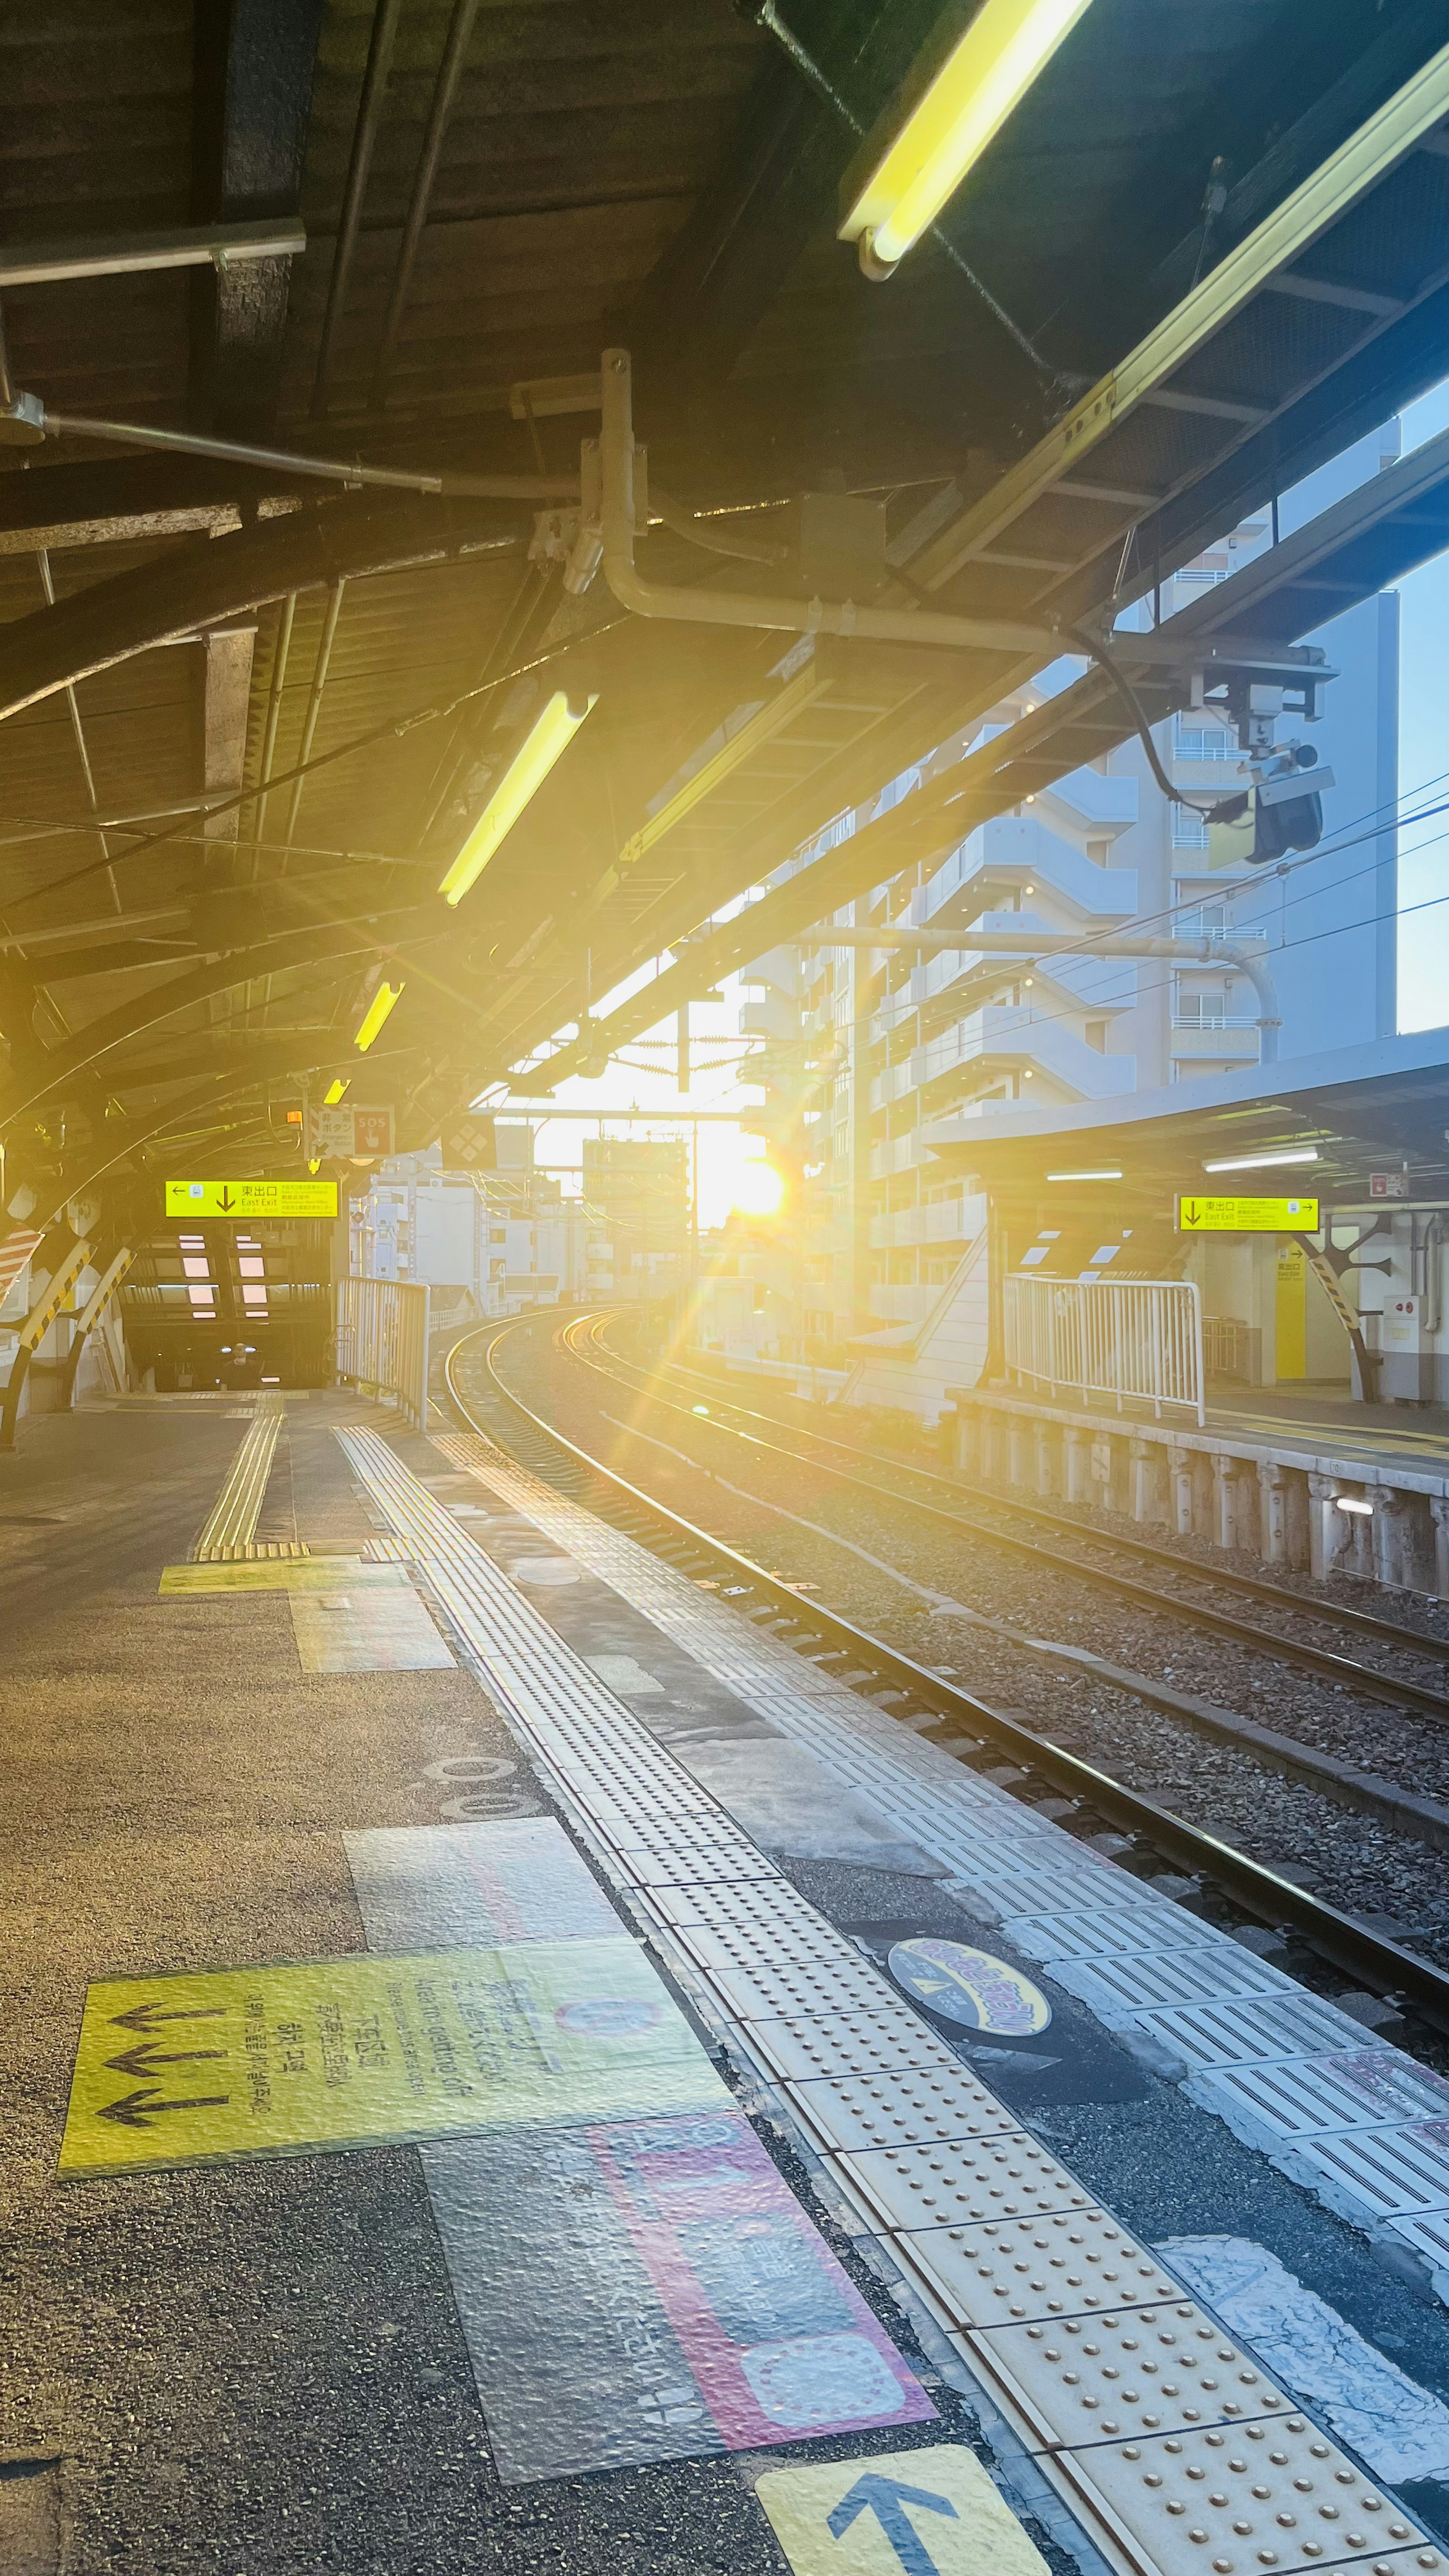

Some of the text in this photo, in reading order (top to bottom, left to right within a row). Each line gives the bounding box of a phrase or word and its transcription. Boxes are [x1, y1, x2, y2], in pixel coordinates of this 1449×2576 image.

[359, 1118, 386, 1128] SOS
[242, 1186, 277, 1196] 東出口
[1206, 1201, 1234, 1211] 東出口
[385, 1981, 408, 2007] Please
[270, 2022, 308, 2074] 하차 구역
[348, 2013, 392, 2069] 下车区域
[397, 2031, 417, 2048] this
[419, 2025, 467, 2075] getting
[401, 2049, 421, 2070] area
[440, 2076, 475, 2099] off
[745, 2238, 800, 2280] 普通
